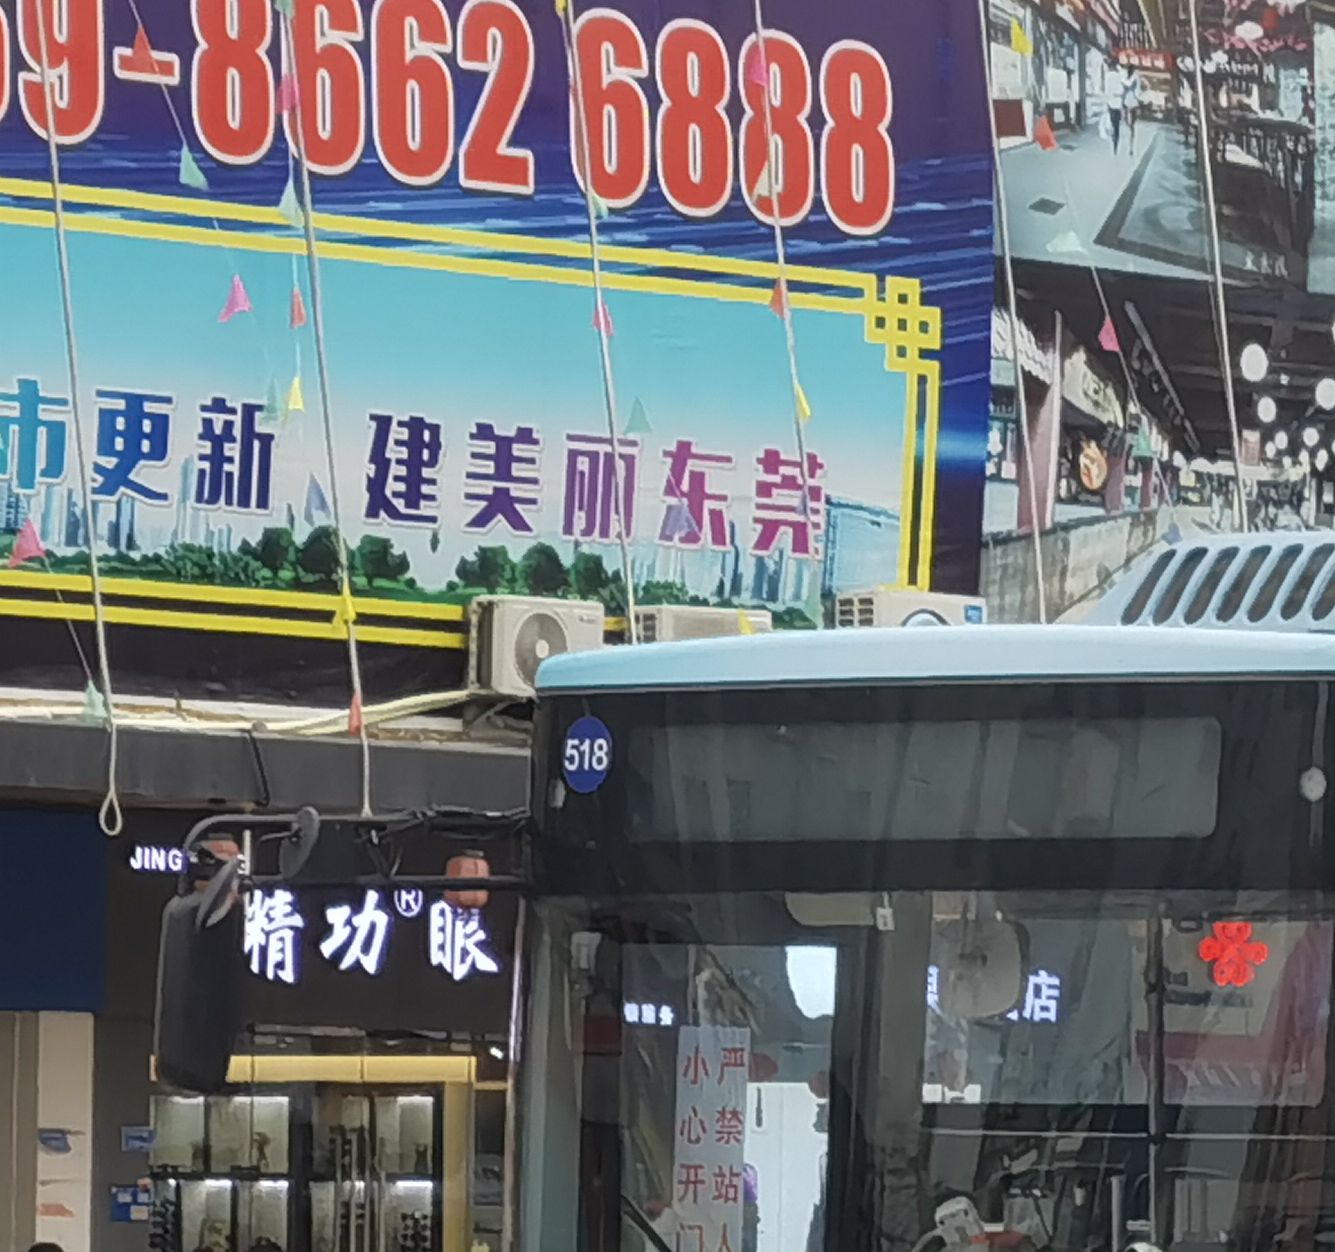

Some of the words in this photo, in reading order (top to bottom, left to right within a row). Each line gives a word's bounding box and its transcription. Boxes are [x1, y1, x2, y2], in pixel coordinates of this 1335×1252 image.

[0, 0, 535, 195] 9-8662
[569, 8, 895, 236] 6888
[0, 377, 276, 511] 市更新
[363, 411, 827, 557] 建美丽东莞
[564, 737, 609, 772] 518
[129, 845, 183, 872] JING
